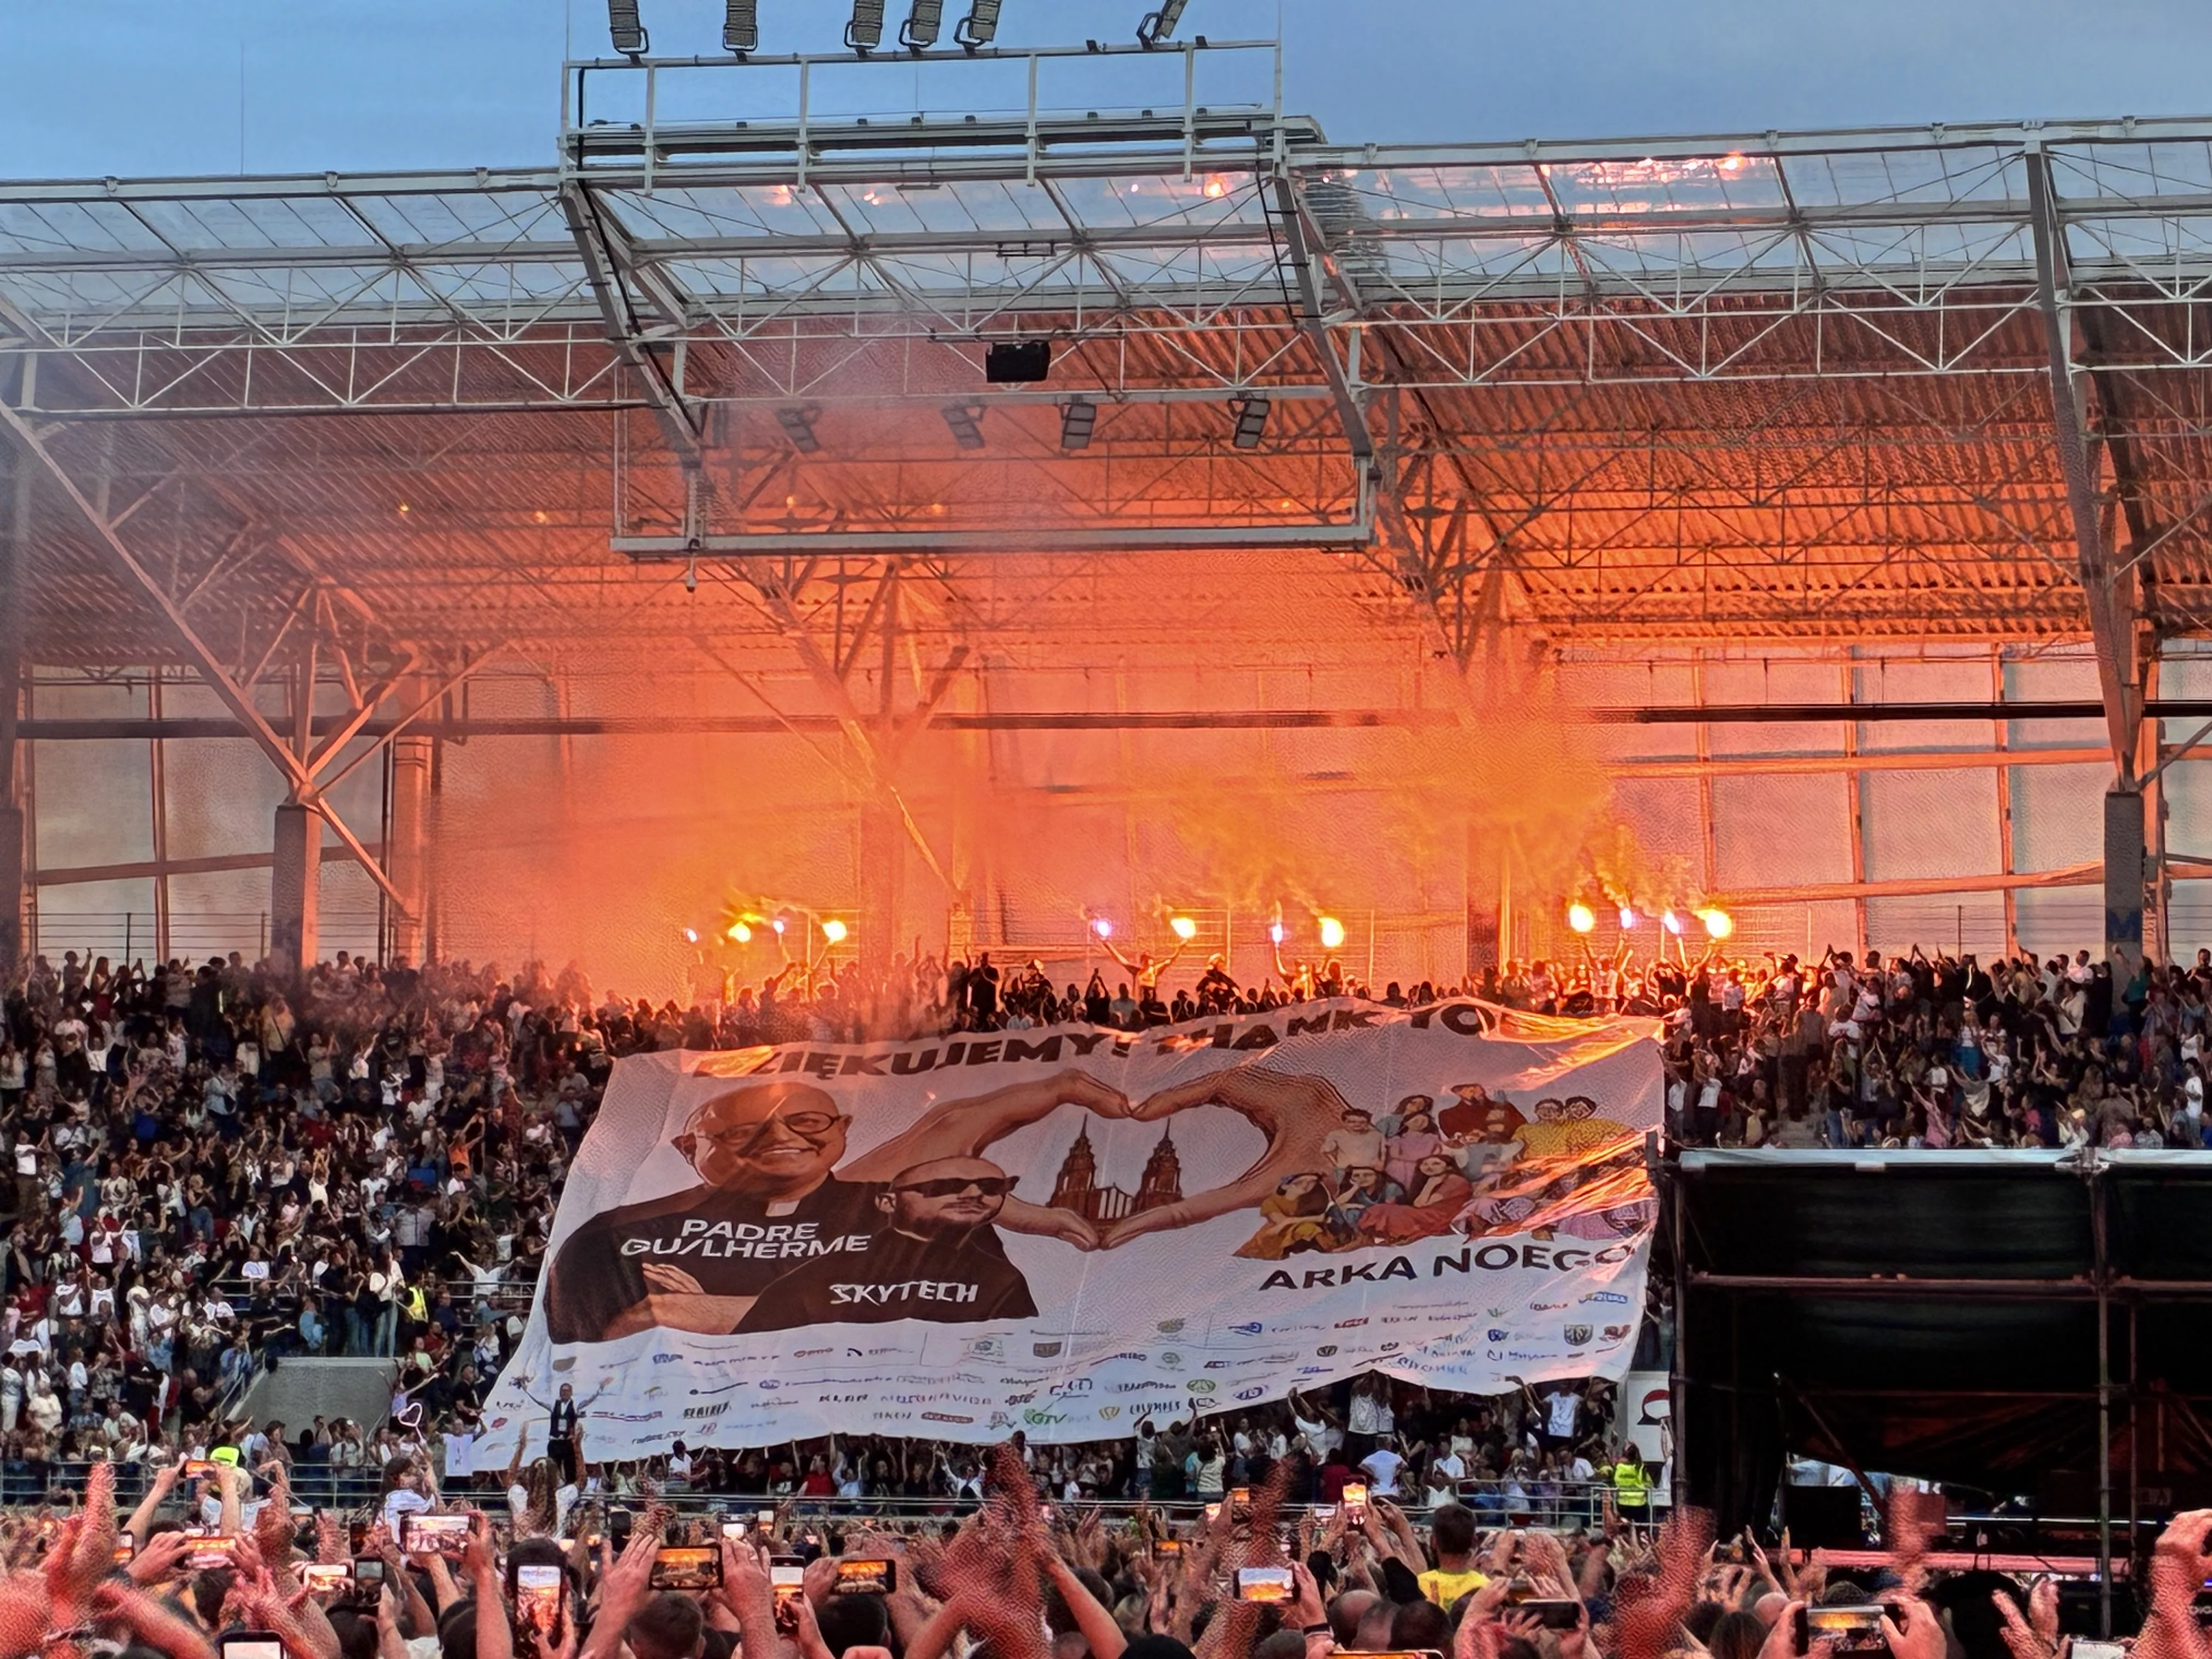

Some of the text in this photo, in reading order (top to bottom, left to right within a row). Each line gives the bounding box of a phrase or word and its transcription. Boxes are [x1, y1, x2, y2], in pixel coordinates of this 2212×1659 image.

[681, 1219, 819, 1241] PADRE
[621, 1235, 871, 1259] GUILHERME
[1259, 1244, 1636, 1291] ARKA NOEGO
[829, 1280, 978, 1306] SKYTECH
